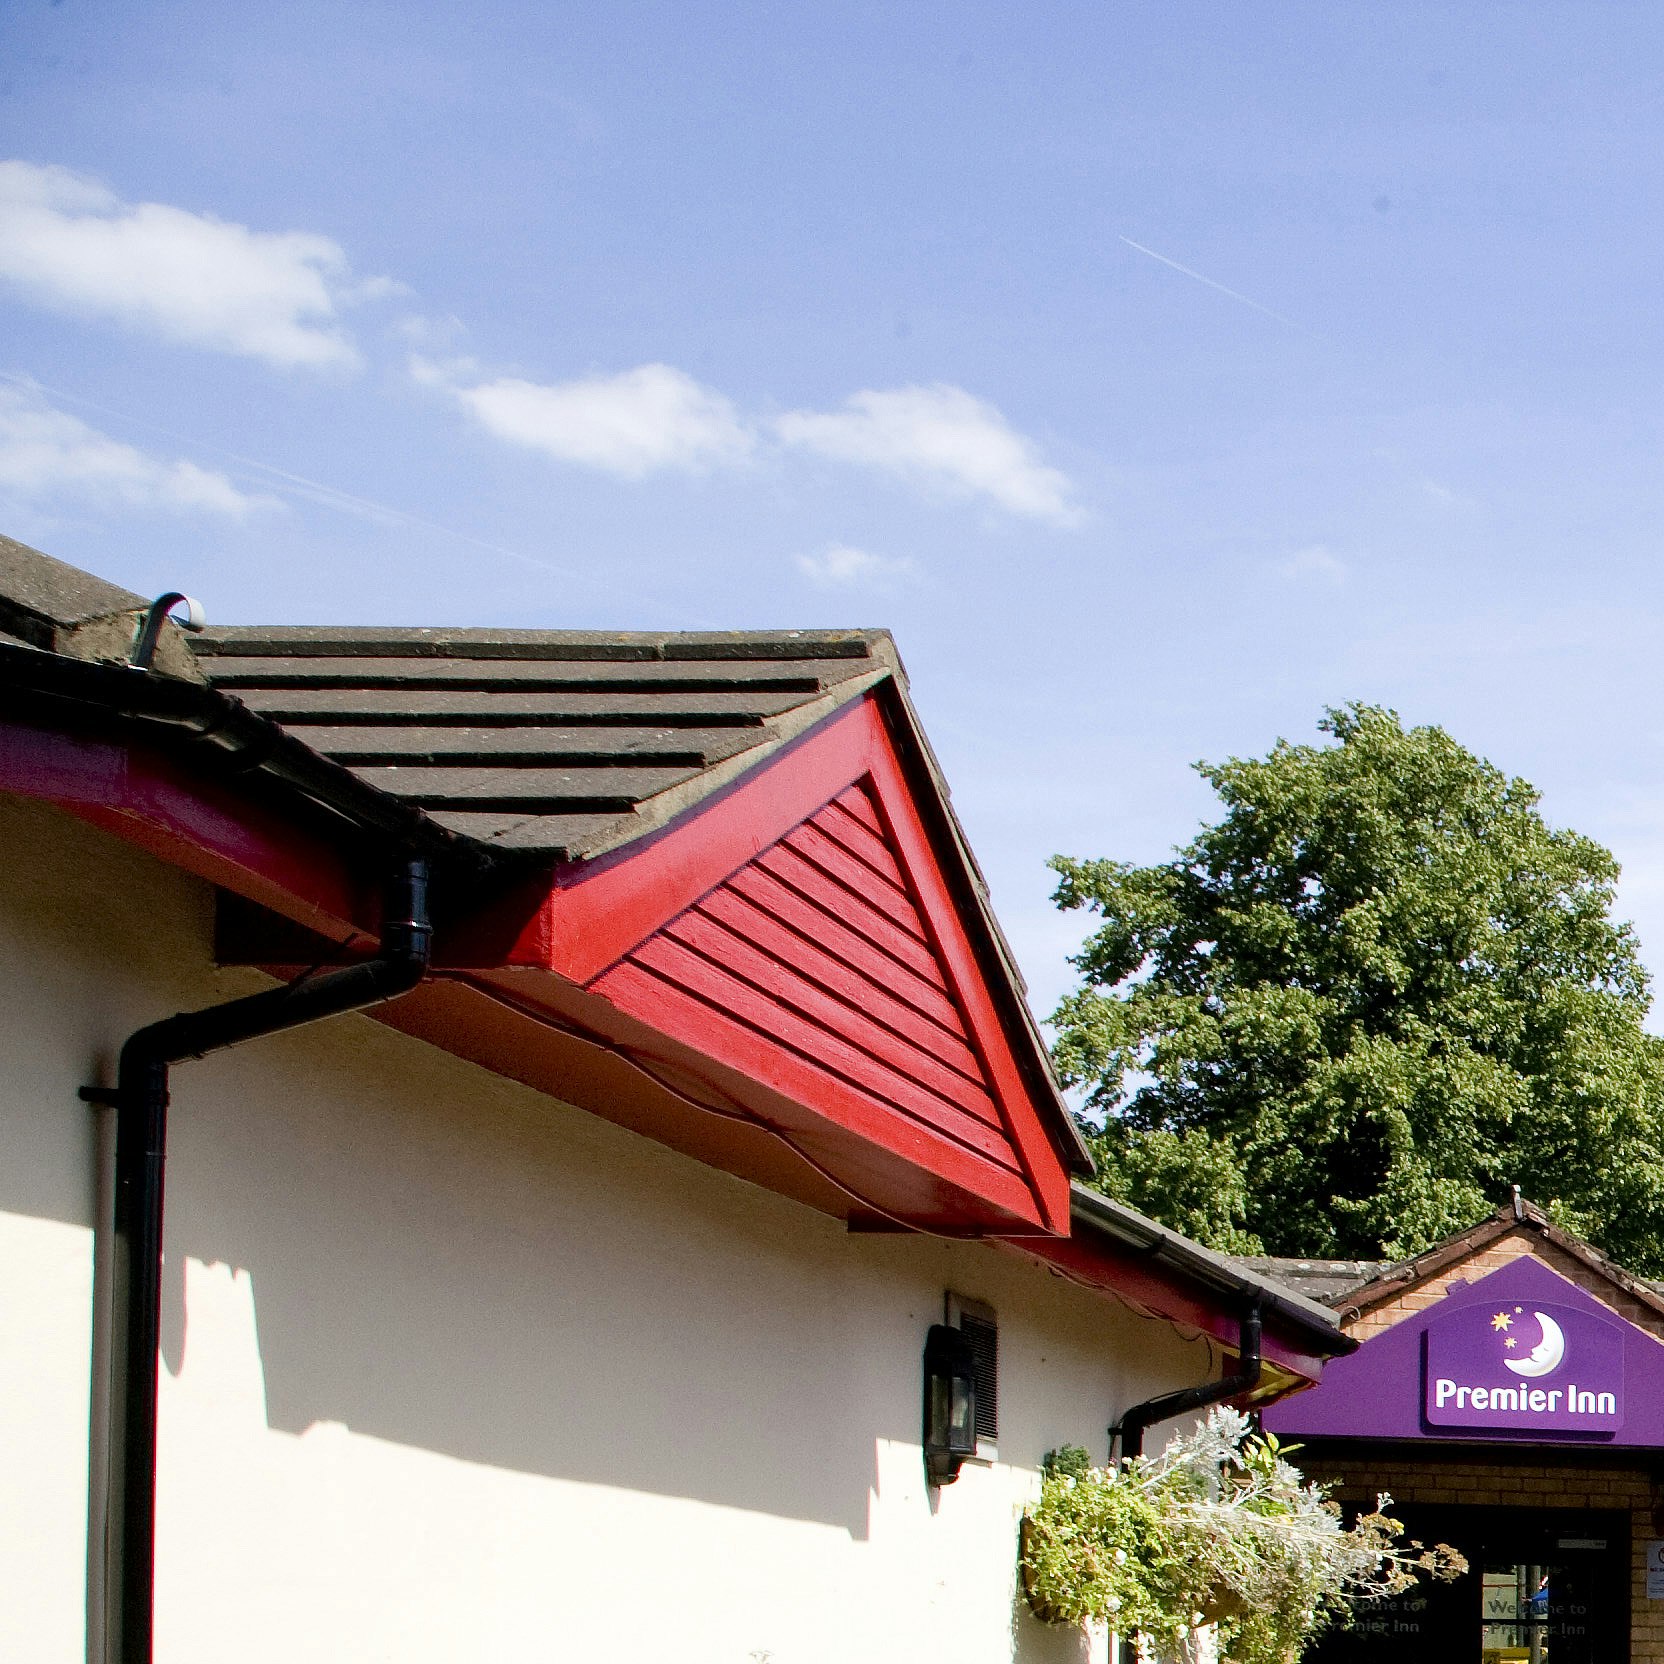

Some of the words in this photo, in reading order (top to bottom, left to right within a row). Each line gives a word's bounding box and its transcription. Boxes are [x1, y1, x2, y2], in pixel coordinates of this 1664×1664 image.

[1435, 1379, 1562, 1412] Premier
[1568, 1384, 1616, 1414] Inn
[1488, 1600, 1565, 1614] Weme
[1570, 1604, 1587, 1614] to
[1393, 1618, 1420, 1632] Inn
[1561, 1622, 1585, 1635] Inn
